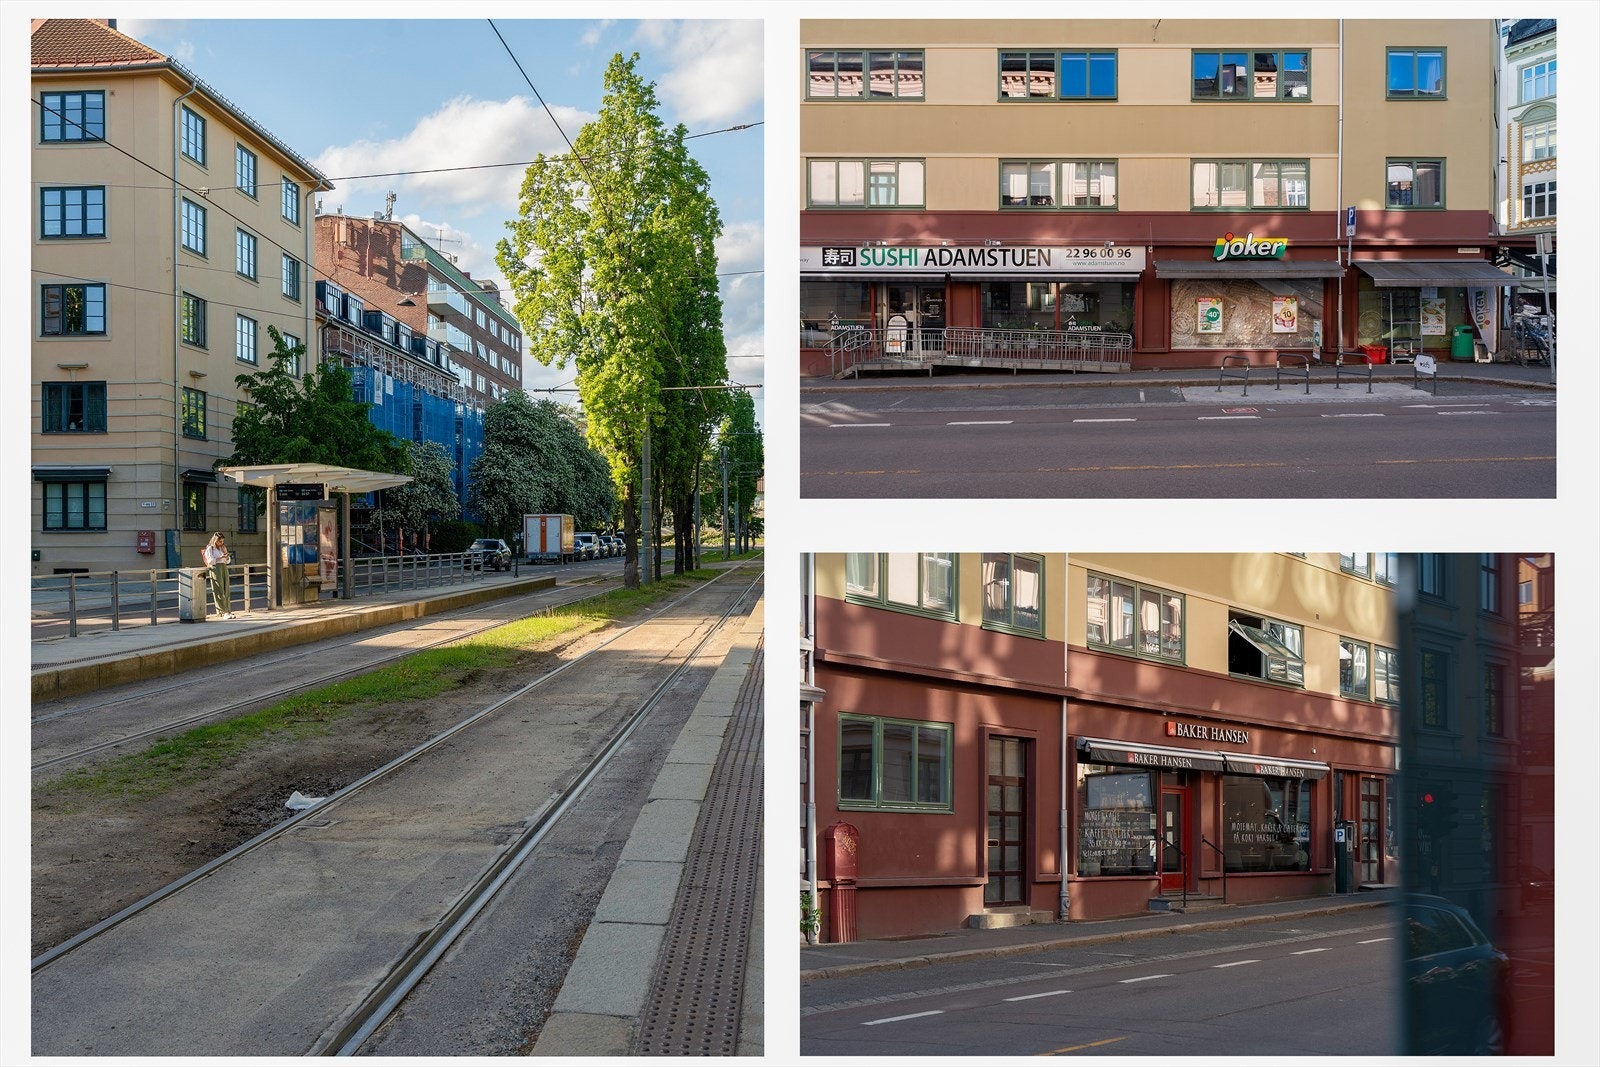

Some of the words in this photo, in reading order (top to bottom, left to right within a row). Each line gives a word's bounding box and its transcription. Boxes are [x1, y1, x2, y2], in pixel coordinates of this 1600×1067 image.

[1348, 209, 1354, 224] P
[1065, 248, 1080, 258] 22
[1083, 248, 1098, 258] 96
[1100, 248, 1114, 258] 00
[1117, 248, 1132, 258] 96
[1216, 232, 1283, 262] joker
[824, 248, 855, 265] 寿司
[860, 248, 918, 267] SUSHI
[923, 248, 1052, 267] ADAMSTUEN
[1283, 310, 1292, 318] 10
[1177, 723, 1209, 739] BAKER
[1211, 727, 1249, 744] HANSEN
[1134, 753, 1159, 766] BAKER
[1161, 756, 1192, 768] HANSEN
[1260, 764, 1279, 775] BAKER
[1279, 767, 1305, 778] HANSEN
[1336, 830, 1344, 841] P
